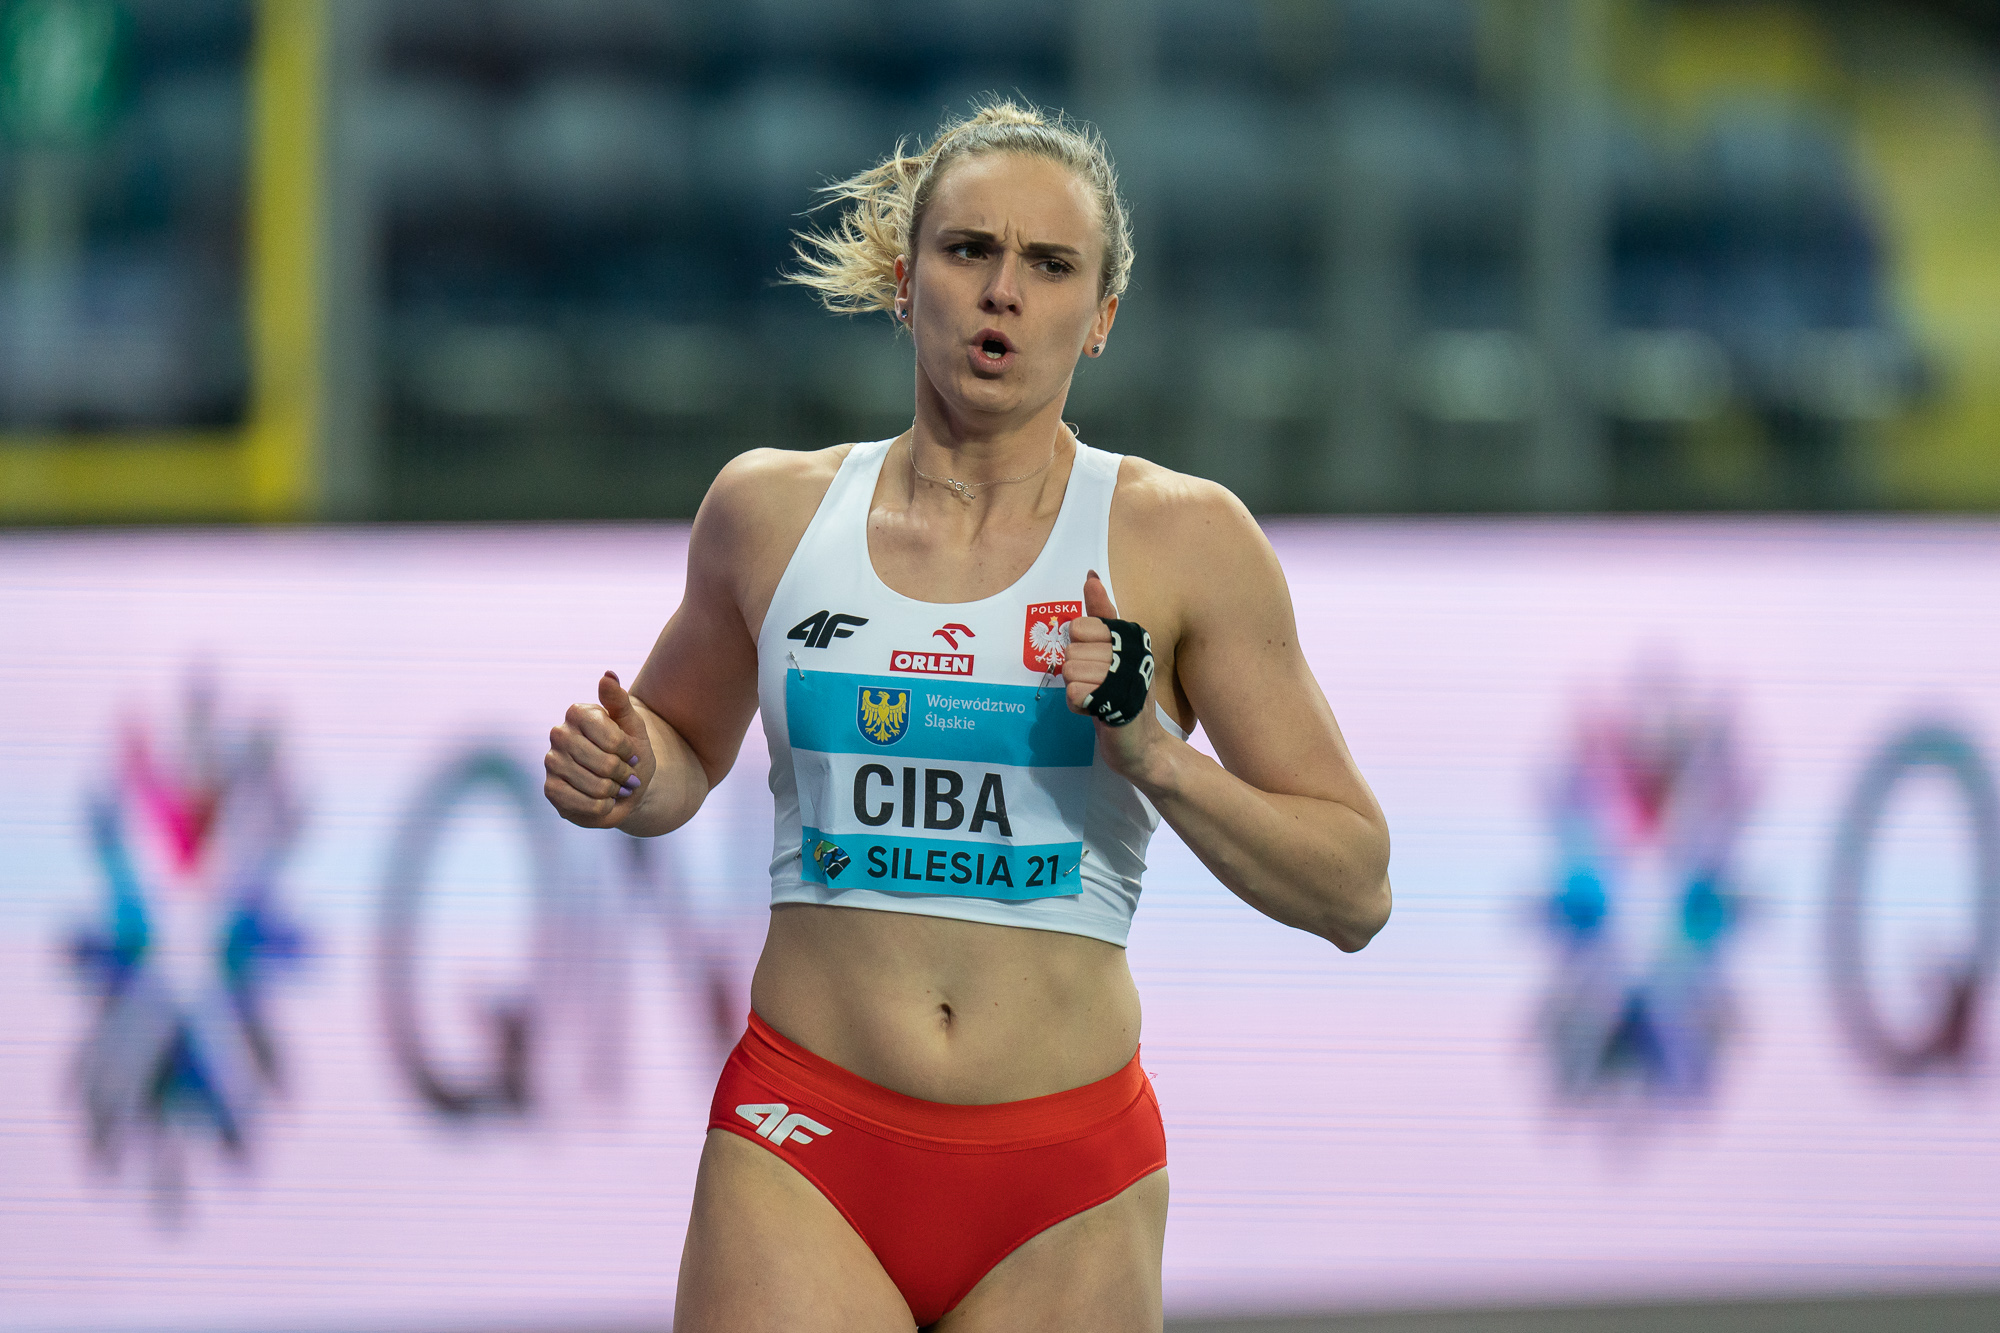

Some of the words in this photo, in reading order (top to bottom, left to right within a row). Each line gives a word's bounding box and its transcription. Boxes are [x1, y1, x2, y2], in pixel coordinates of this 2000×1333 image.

[1031, 604, 1078, 615] POLSKA
[787, 610, 869, 648] 4F
[894, 653, 970, 673] ORLEN
[926, 694, 1026, 714] Województwo
[925, 711, 976, 731] Śląskie
[853, 763, 1014, 837] CIBA
[867, 845, 1015, 888] SILESIA
[1025, 855, 1060, 888] 21
[735, 1103, 833, 1147] 4F
